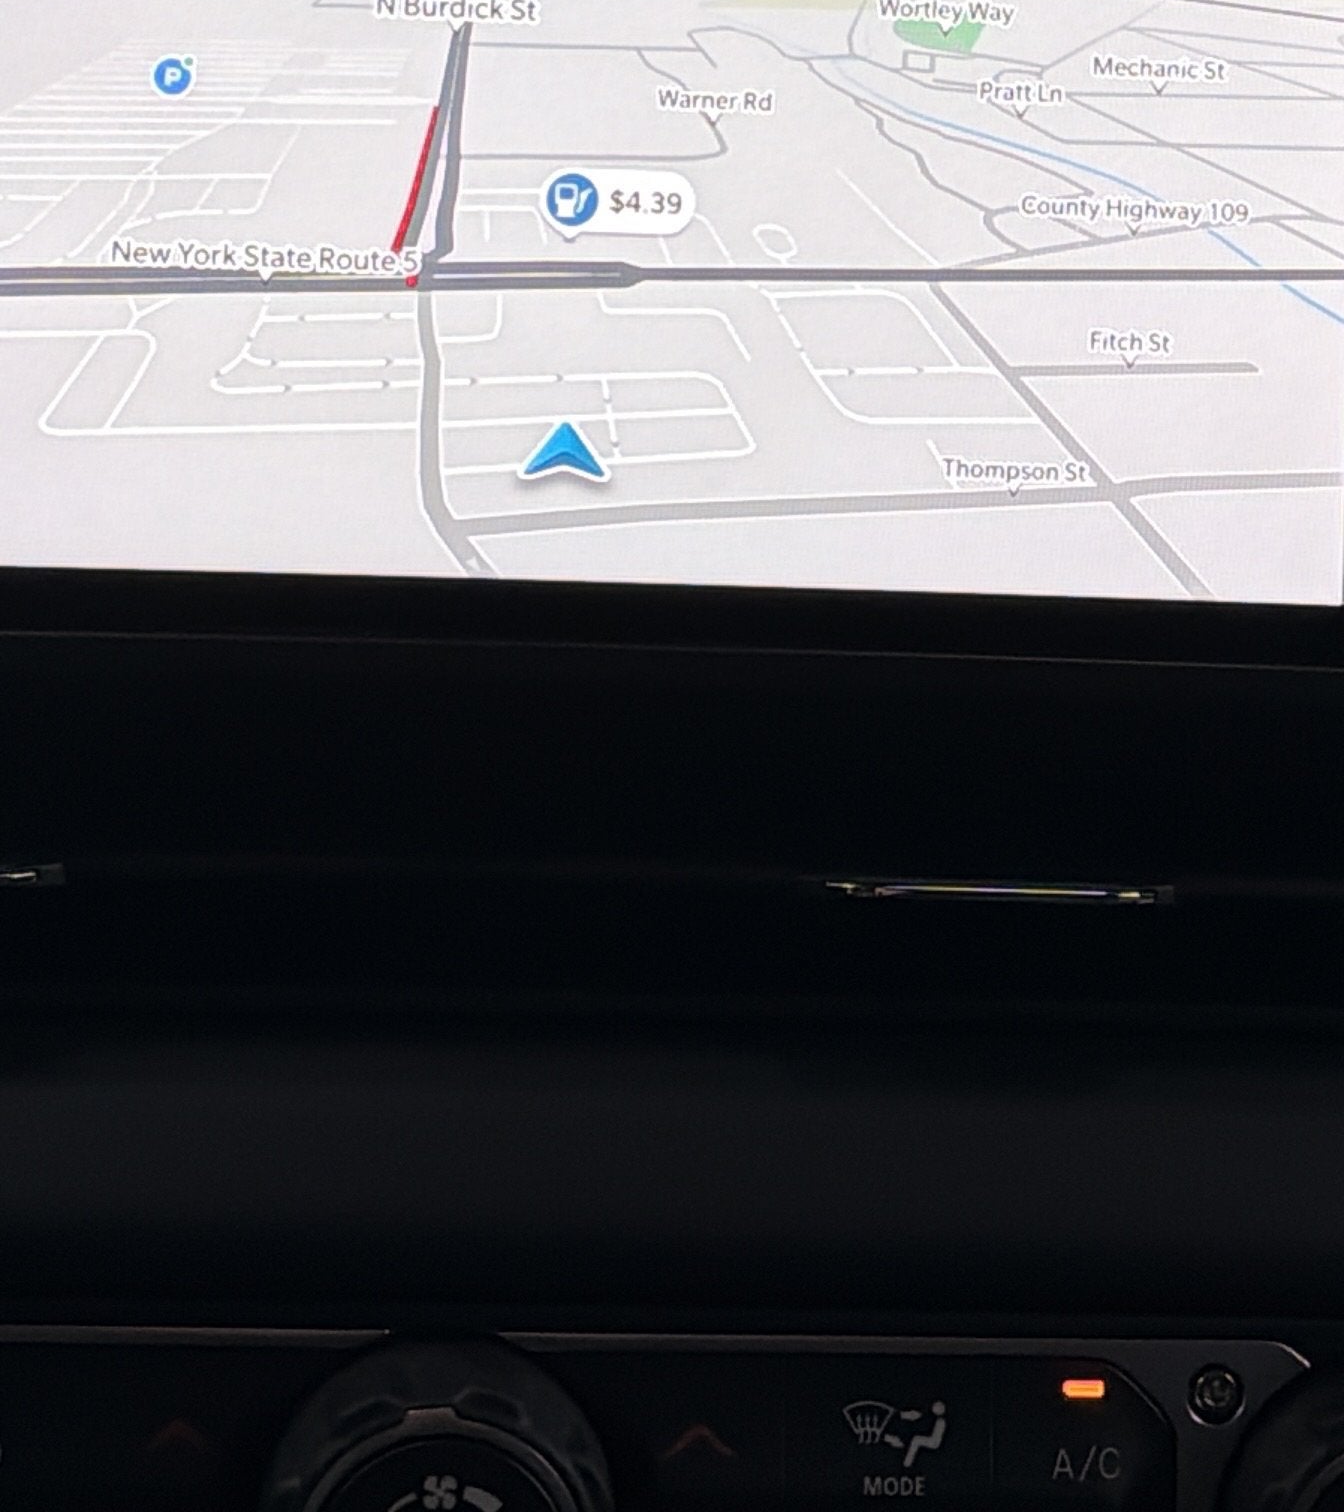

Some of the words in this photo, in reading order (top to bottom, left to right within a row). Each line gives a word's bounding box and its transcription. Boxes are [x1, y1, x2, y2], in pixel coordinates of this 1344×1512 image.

[968, 4, 1014, 25] Way
[1093, 57, 1198, 80] Mechanic
[1203, 61, 1224, 81] St
[658, 89, 738, 110] Warner
[743, 91, 772, 111] Rd
[979, 83, 1032, 102] Pratt
[1038, 85, 1063, 104] Ln
[609, 191, 681, 216] $4.39
[1022, 197, 1101, 221] County
[1106, 199, 1202, 224] Highway
[1210, 203, 1248, 222] 109
[112, 241, 174, 265] New
[179, 243, 235, 268] York
[245, 245, 312, 271] State
[320, 248, 395, 274] Route
[403, 250, 418, 272] 5
[1089, 331, 1143, 352] Fitch
[1149, 334, 1170, 353] St
[943, 457, 1060, 483] Thompson
[1065, 462, 1086, 482] St
[1053, 1447, 1122, 1482] A/C
[863, 1475, 926, 1497] MODE
